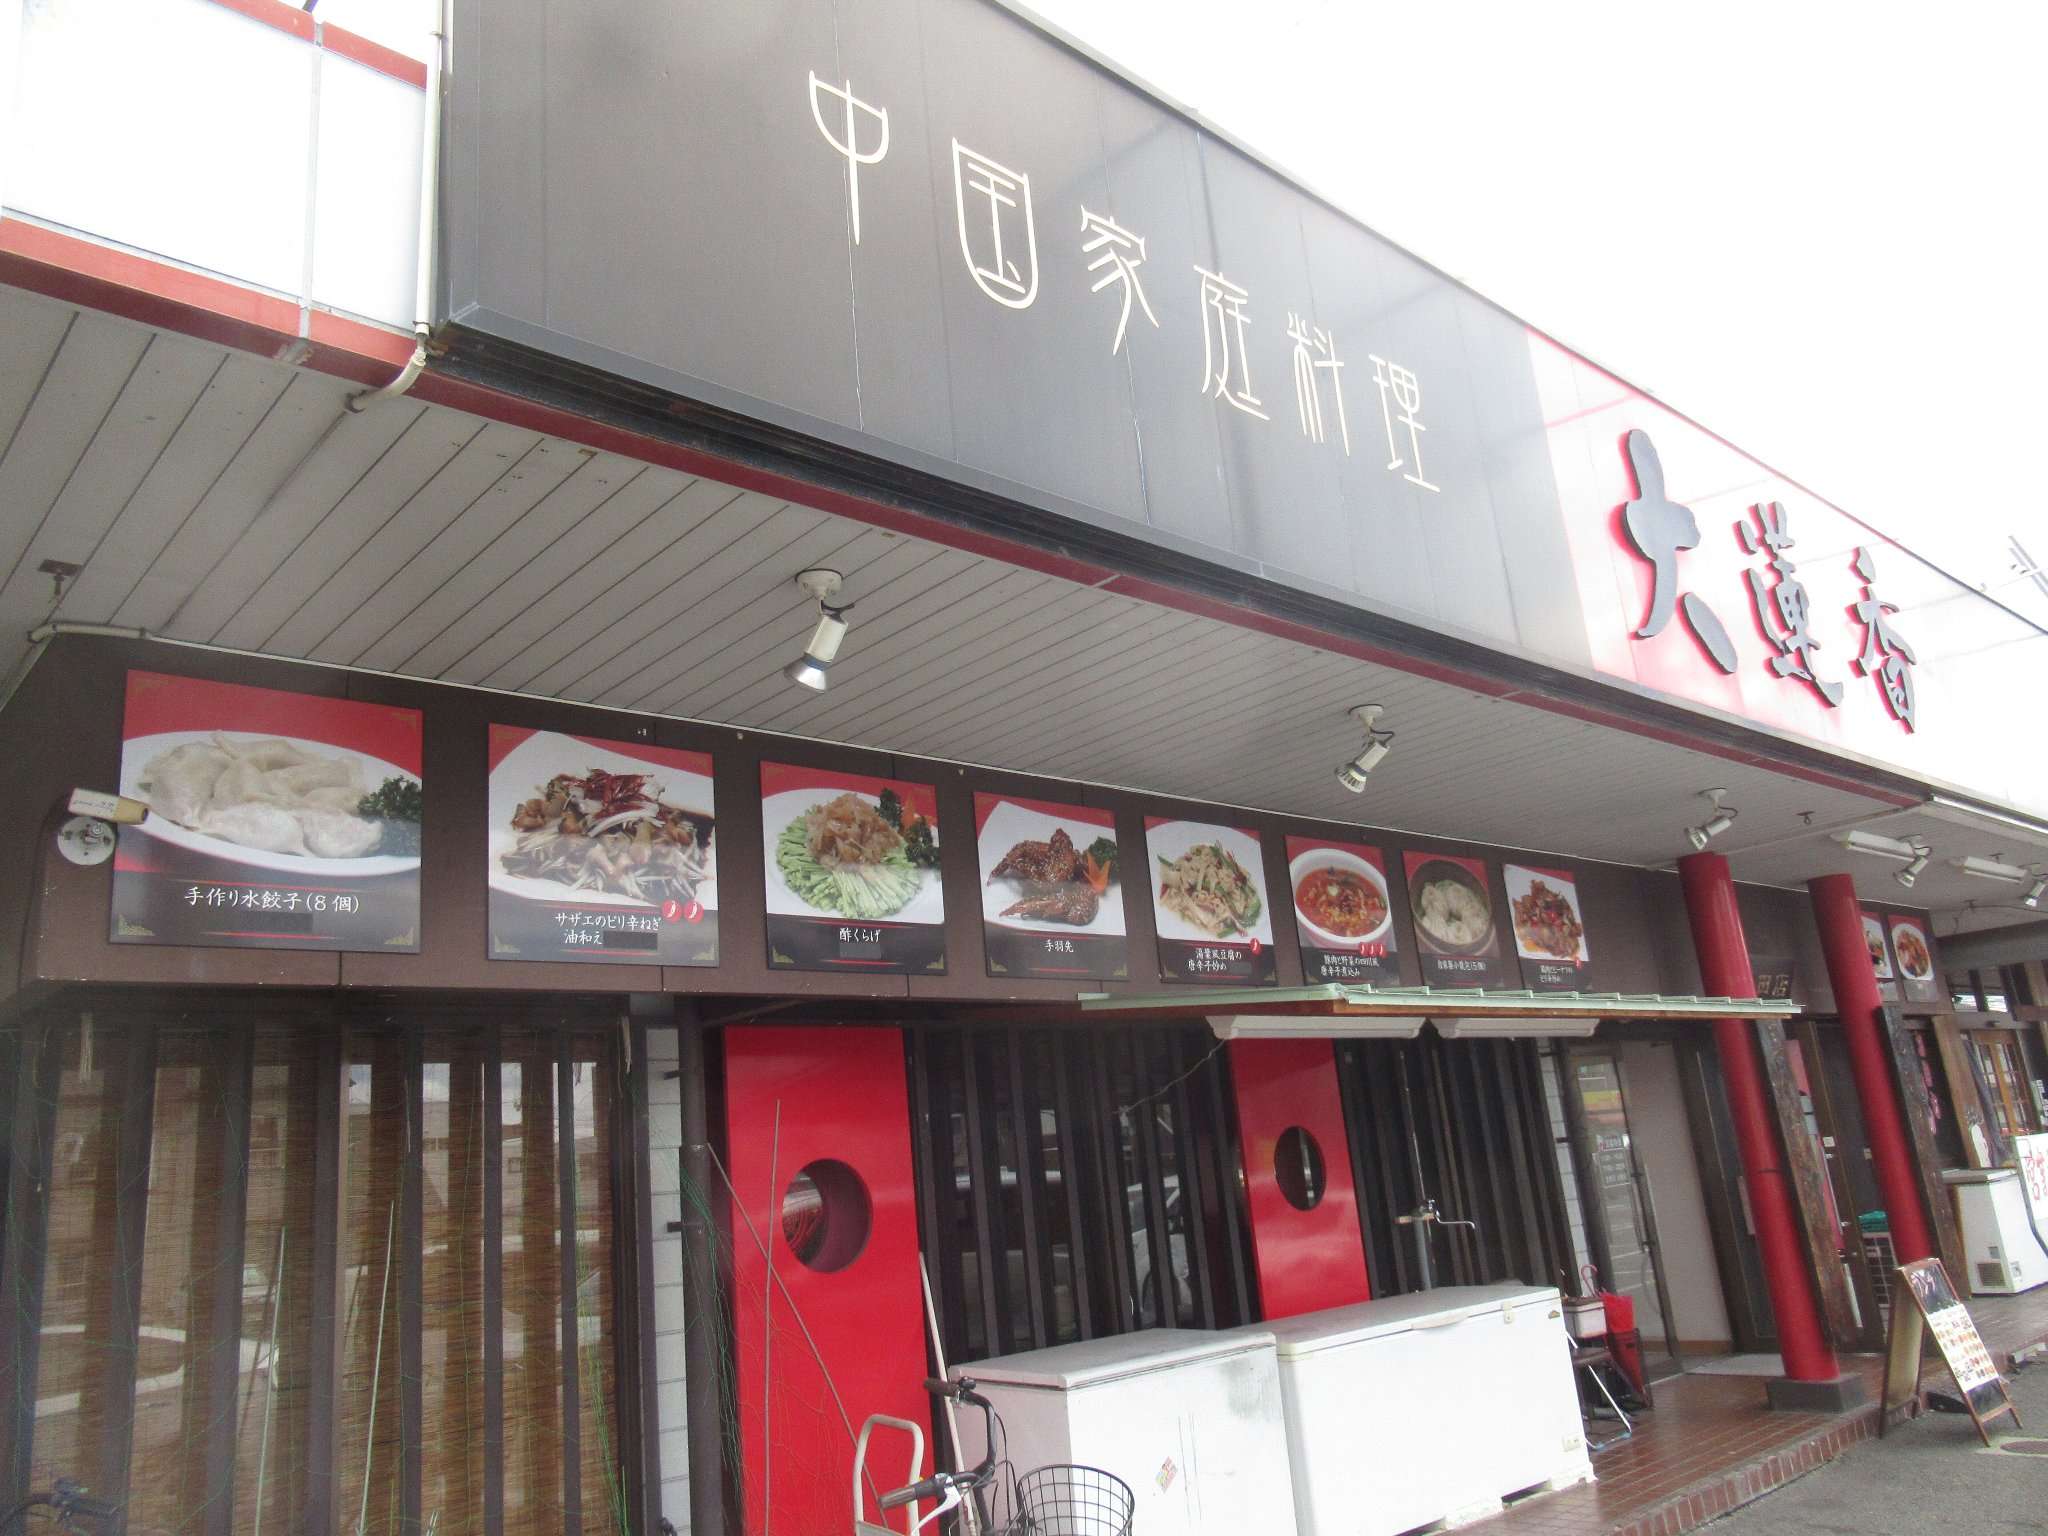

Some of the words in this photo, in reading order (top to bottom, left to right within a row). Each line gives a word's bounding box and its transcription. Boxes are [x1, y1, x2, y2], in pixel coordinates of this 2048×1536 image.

[808, 69, 1441, 493] 中国家庭料理
[184, 886, 359, 913] 手作り水餃子(8個)
[555, 912, 662, 931] サザエのピリ辛ねぎ
[564, 929, 603, 945] 油和え
[839, 927, 881, 943] 酢くらげ
[1043, 938, 1074, 953] 手羽先
